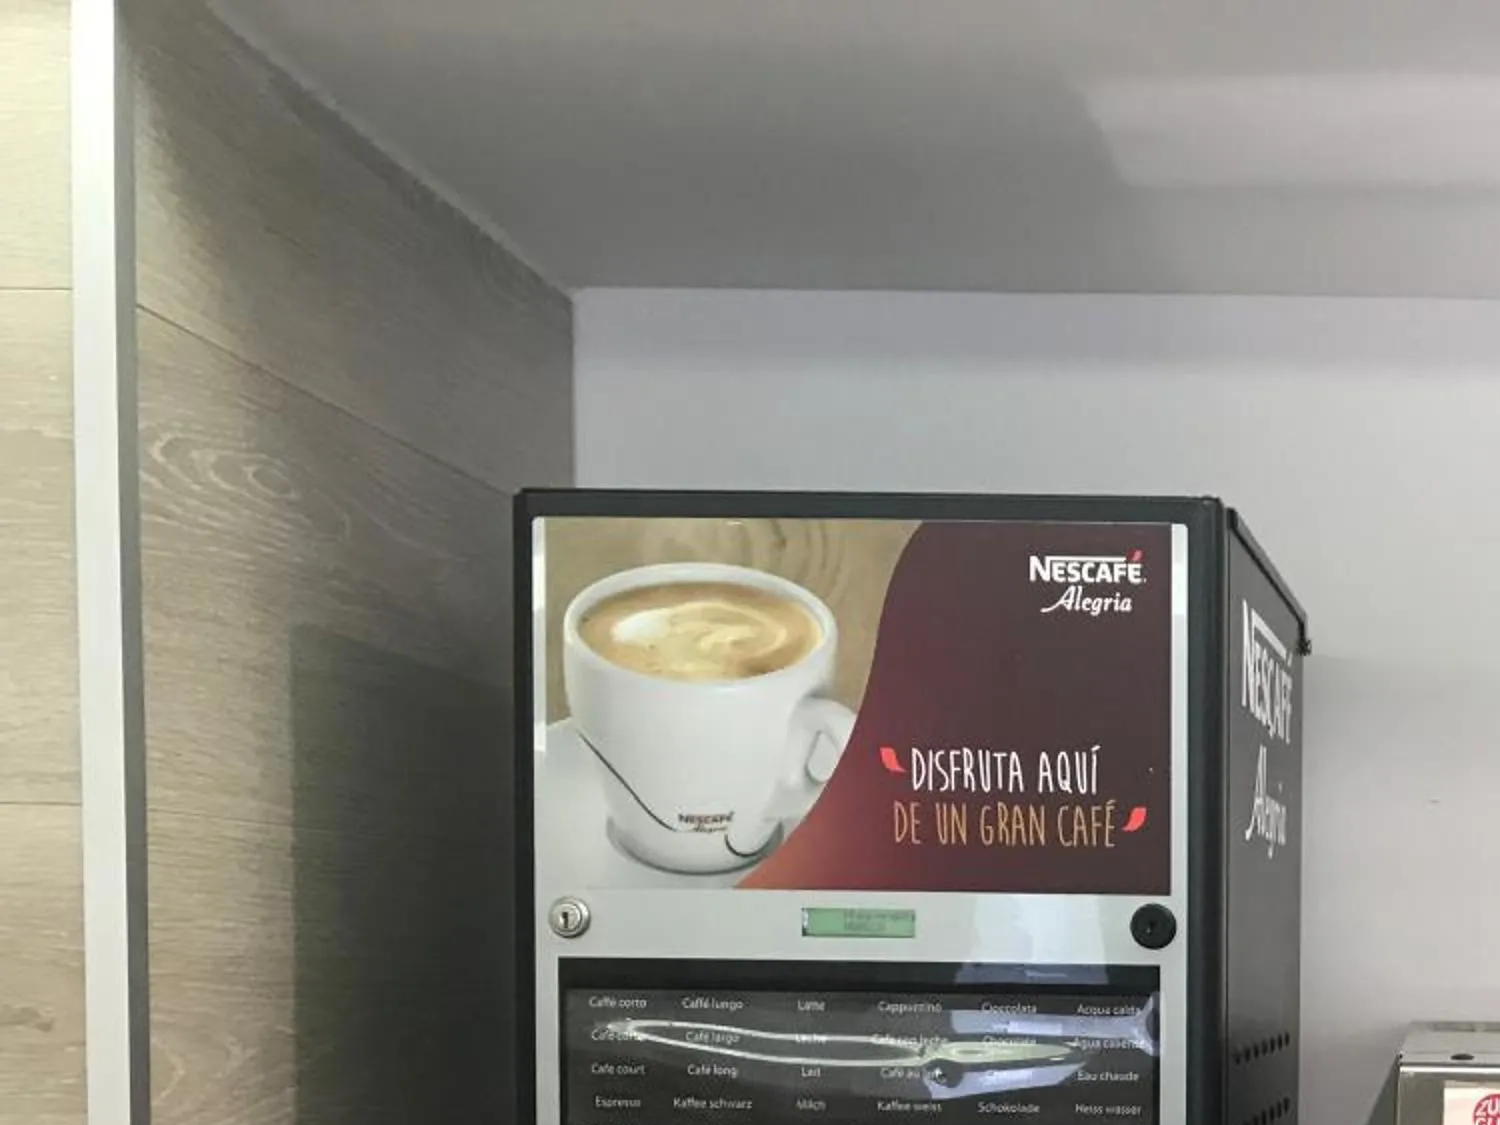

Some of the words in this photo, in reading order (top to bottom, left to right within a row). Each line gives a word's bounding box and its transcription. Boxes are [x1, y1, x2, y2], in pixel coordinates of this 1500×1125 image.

[1029, 550, 1143, 584] NESCAFÉ
[1040, 585, 1132, 616] Alegria
[911, 747, 1024, 793] DISFRUTA
[1038, 745, 1100, 794] AQUÍ
[894, 800, 922, 845] DE
[936, 802, 967, 845] UN
[980, 802, 1046, 846] GRAN
[1057, 799, 1116, 847] CAFÉ
